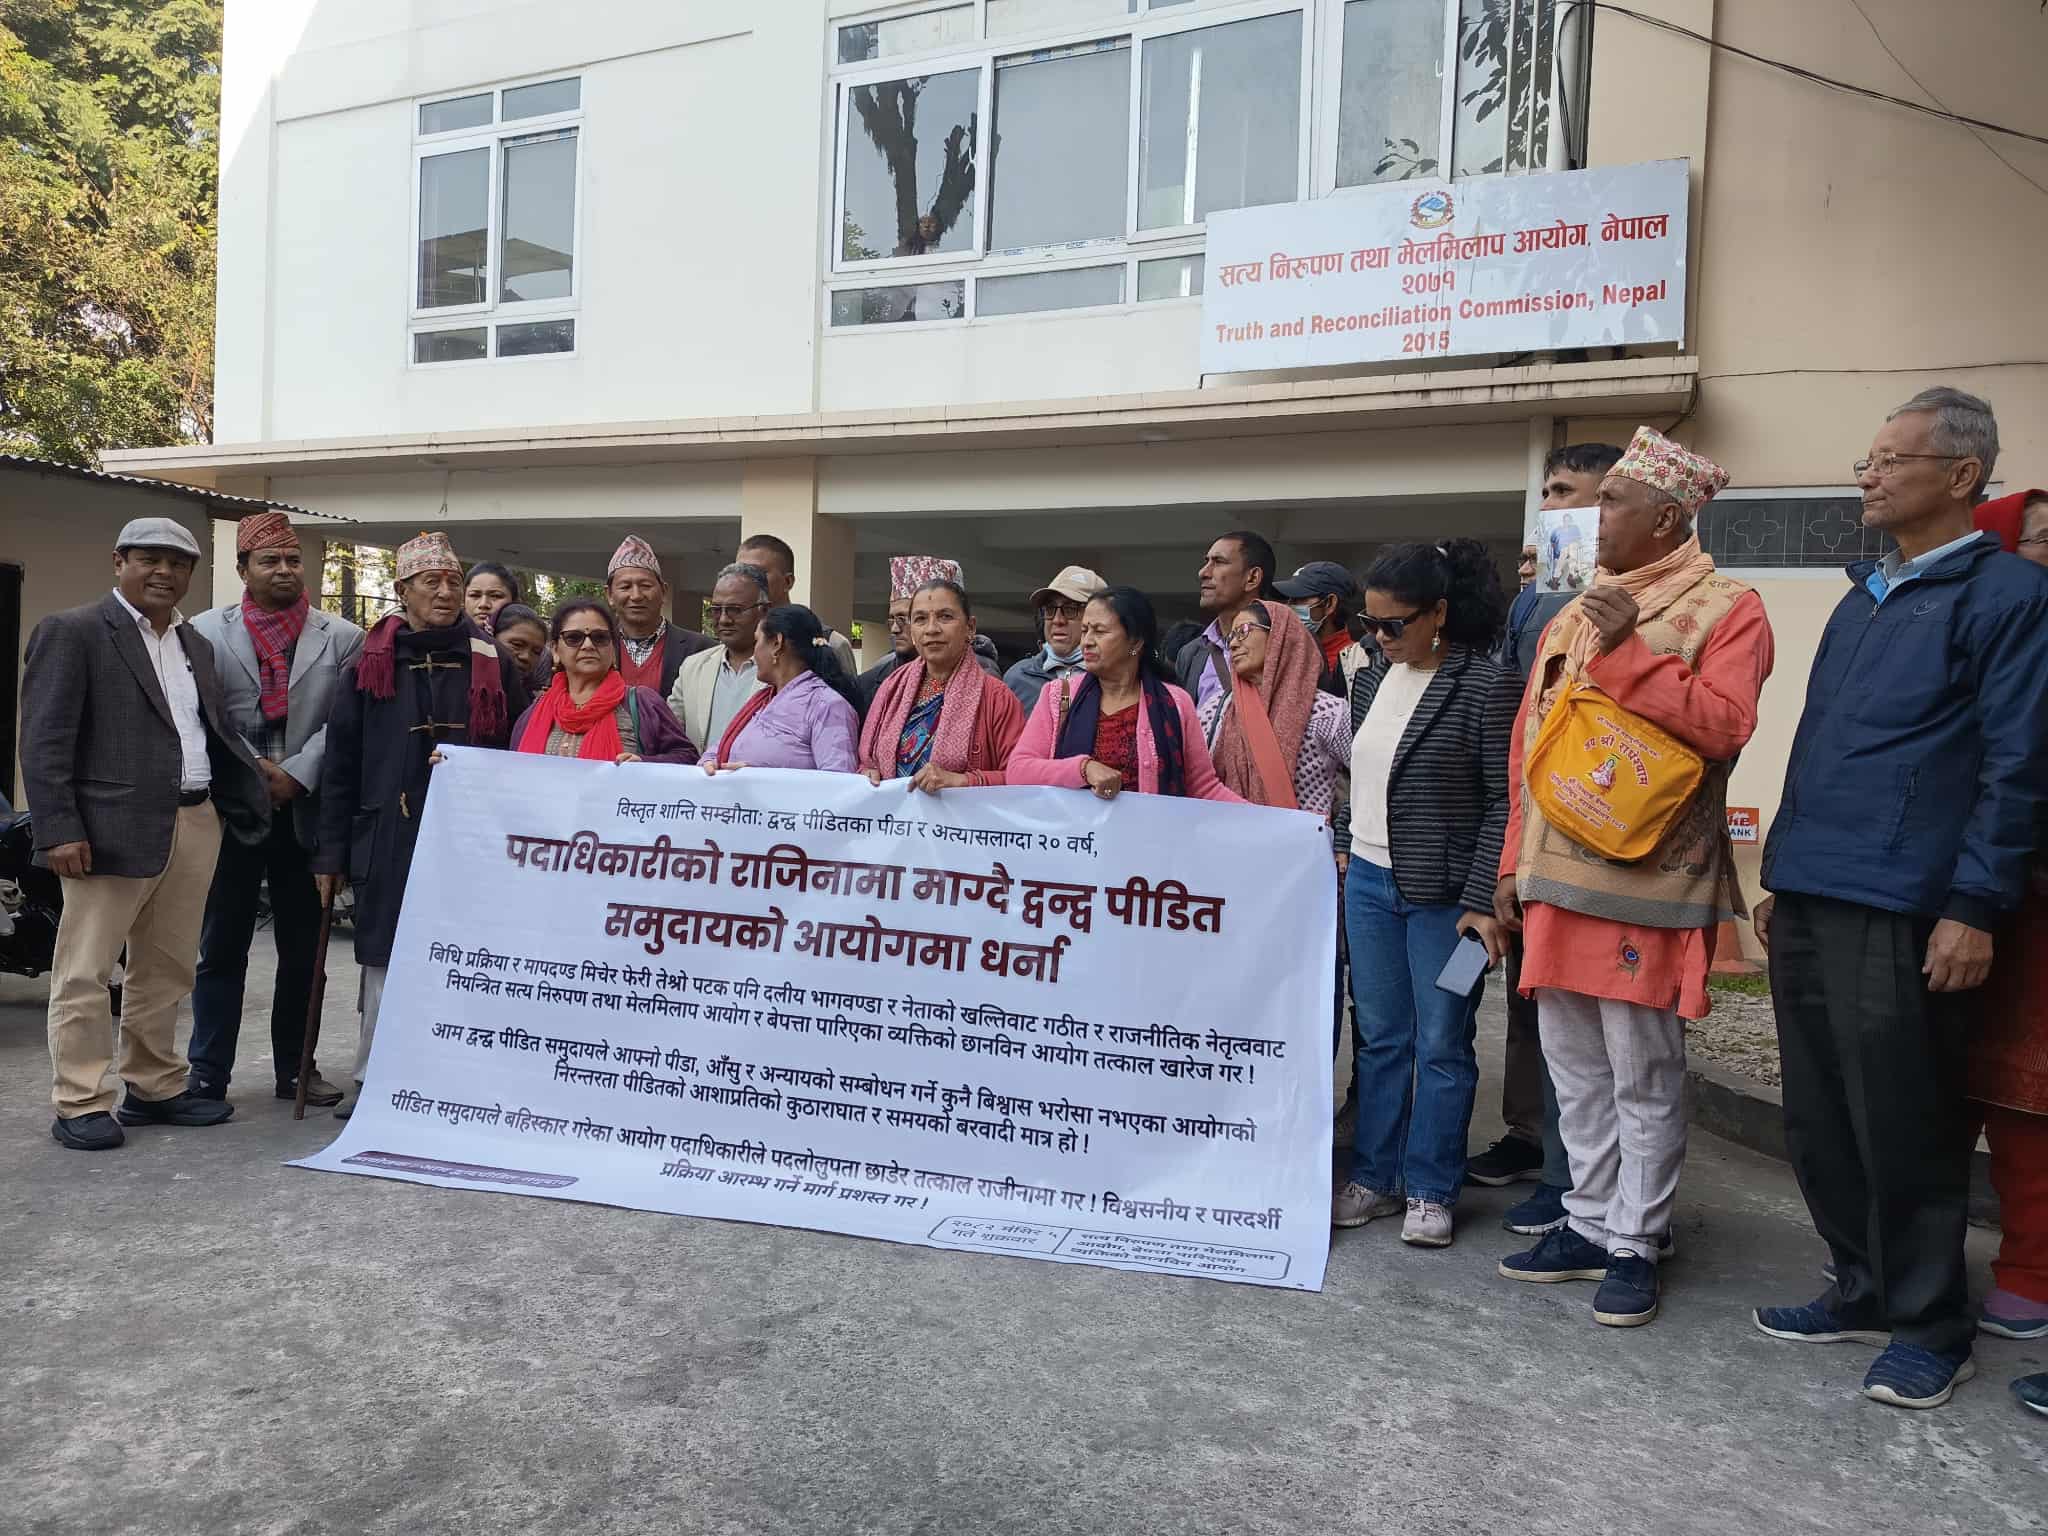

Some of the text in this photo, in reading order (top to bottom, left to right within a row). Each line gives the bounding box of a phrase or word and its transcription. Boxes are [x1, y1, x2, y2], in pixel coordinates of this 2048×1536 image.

[1219, 261, 1264, 287] सत्य
[1350, 246, 1391, 272] तथा
[1397, 232, 1506, 264] मेलमिलाप
[1601, 213, 1670, 242] नेपाल
[1401, 270, 1455, 294] २०७१
[1216, 279, 1666, 343] Truth and Reconciliation Commission, Nepal
[1402, 330, 1450, 353] 2015
[616, 797, 657, 823] विस्तृत
[660, 798, 697, 820] शान्ति
[767, 810, 800, 833] द्वन्द्व
[802, 808, 872, 834] पीडितका
[877, 814, 912, 837] पीडा
[917, 821, 928, 838] र
[932, 824, 1032, 850] अत्यासलाग्दा
[1038, 833, 1060, 851] २०
[1067, 831, 1098, 858] वर्ष,
[506, 830, 1225, 934] पदाधिकारीको राजिनामा माग्दै द्वन्द्व पीडित
[605, 903, 1071, 983] समुदायको आयोगमा धर्ना
[446, 969, 502, 996] नियन्त्रित
[504, 981, 534, 1000] सत्य
[537, 980, 588, 1006] निरुपण
[592, 992, 622, 1011] तथा
[626, 990, 700, 1019] मेलमिलाप
[703, 1002, 750, 1026] आयोग
[754, 1010, 764, 1027] र
[767, 1006, 812, 1033] बेपत्ता
[816, 1014, 884, 1042] पारिएका
[887, 1022, 957, 1050] व्यक्तिको
[961, 1033, 1027, 1059] छानविन
[1031, 1041, 1089, 1067] आयोग
[1094, 1051, 1155, 1075] तत्काल
[1160, 1054, 1214, 1080] खारेज
[1219, 1064, 1243, 1083] गर
[465, 947, 510, 972] प्रक्रिया
[512, 957, 521, 973] र
[524, 958, 578, 979] मापदण्ड
[581, 960, 618, 985] मिचेर
[622, 964, 652, 988] फेरी
[656, 968, 689, 992] तेश्रो
[693, 977, 730, 996] पटक
[733, 977, 761, 1000] पनि
[764, 981, 806, 1005] दलीय
[811, 990, 883, 1015] भागवण्डा
[888, 998, 898, 1016] र
[902, 994, 957, 1022] नेताको
[960, 1003, 1039, 1032] खल्तिवाट
[1043, 1013, 1089, 1039] गठीत
[1094, 1023, 1104, 1041] र
[1109, 1023, 1201, 1050] राजनीतिक
[1205, 1028, 1286, 1060] नेतृत्ववाट
[432, 1022, 464, 1041] आम
[466, 1027, 496, 1049] द्वन्द्व
[498, 1026, 542, 1052] पीडित
[545, 1037, 610, 1062] समुदायले
[613, 1045, 661, 1068] आफ्नो
[665, 1048, 699, 1077] पीडा,
[706, 1054, 742, 1085] आँसु
[746, 1063, 756, 1081] र
[760, 1067, 835, 1090] अन्यायको
[839, 1073, 907, 1099] सम्बोधन
[911, 1080, 938, 1103] गर्ने
[941, 1084, 972, 1112] कुनै
[1038, 1097, 1094, 1125] भरोसा
[1098, 1107, 1167, 1135] नभएका
[1172, 1114, 1257, 1142] आयोगको
[554, 1058, 619, 1089] निरन्तरता
[623, 1070, 686, 1099] पीडितको
[690, 1084, 782, 1112] आशाप्रतिको
[786, 1096, 867, 1122] कुठाराघात
[872, 1107, 882, 1124] र
[886, 1108, 951, 1134] समयको
[956, 1118, 1016, 1142] बरवादी
[1021, 1127, 1054, 1148] मात्र
[1058, 1127, 1078, 1153] हो
[391, 1090, 434, 1115] पीडित
[437, 1100, 502, 1125] समुदायले
[504, 1107, 569, 1137] बहिस्कार
[572, 1116, 613, 1143] गरेका
[616, 1125, 666, 1151] आयोग
[670, 1133, 767, 1165] पदाधिकारीले
[771, 1147, 861, 1180] पदलोलुपता
[865, 1160, 910, 1186] छाडेर
[914, 1169, 973, 1195] तत्काल
[977, 1176, 1056, 1207] राजीनामा
[1061, 1190, 1086, 1211] गर
[1195, 1206, 1207, 1223] र
[1212, 1207, 1282, 1230] पारदर्शी
[659, 1158, 715, 1182] प्रक्रिया
[718, 1170, 771, 1189] आरम्भ
[773, 1174, 803, 1193] गर्ने
[802, 1180, 840, 1198] मार्ग
[838, 1187, 891, 1205] प्रशस्त
